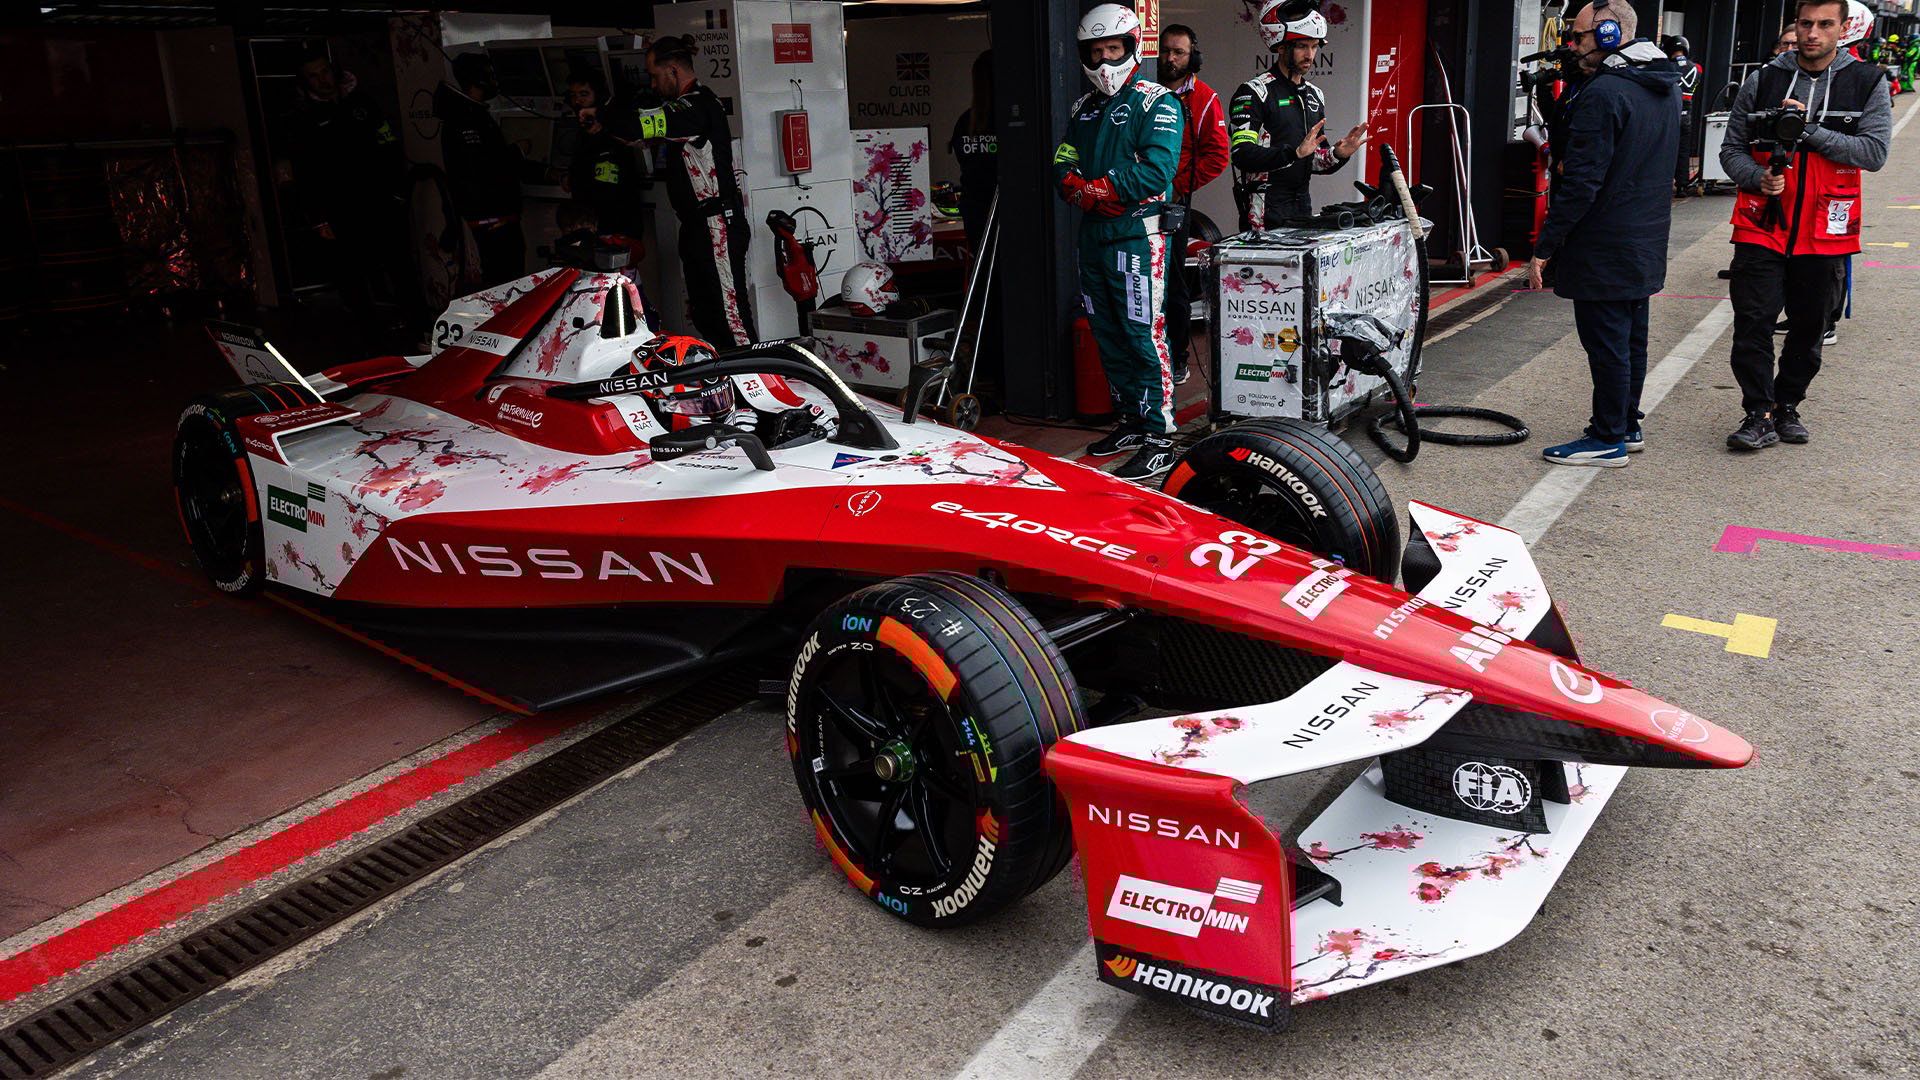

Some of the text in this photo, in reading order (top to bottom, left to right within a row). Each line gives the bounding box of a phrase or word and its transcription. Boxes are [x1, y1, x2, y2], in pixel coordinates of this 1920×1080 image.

[695, 32, 729, 42] NORMAN
[703, 44, 730, 55] NATO
[709, 58, 732, 79] 23
[888, 84, 930, 97] OLIVER
[857, 102, 932, 117] ROWLAND
[963, 143, 978, 154] OF
[1130, 253, 1143, 318] ELECTROMIN
[1227, 298, 1296, 316] NISSAN
[435, 319, 464, 350] 23
[467, 334, 500, 350] NISSAN
[751, 339, 786, 351] nismo
[599, 372, 669, 394] NISSAN
[700, 382, 730, 398] NISSAN
[742, 379, 760, 391] 23
[748, 388, 765, 399] NAT
[628, 410, 649, 423] 23
[633, 420, 654, 432] NAT
[1247, 451, 1327, 519] Hankook
[270, 495, 326, 528] ELECTROMIN
[385, 536, 715, 586] NISSAN
[1189, 529, 1282, 581] 23
[1443, 557, 1509, 610] NISSAN
[1372, 596, 1430, 640] nismo
[1282, 680, 1380, 749] NISSAN
[1667, 710, 1693, 742] NISSAN
[1088, 803, 1241, 849] NISSAN
[1119, 889, 1250, 934] ELECTROMIN
[1132, 960, 1275, 1018] Hankook
